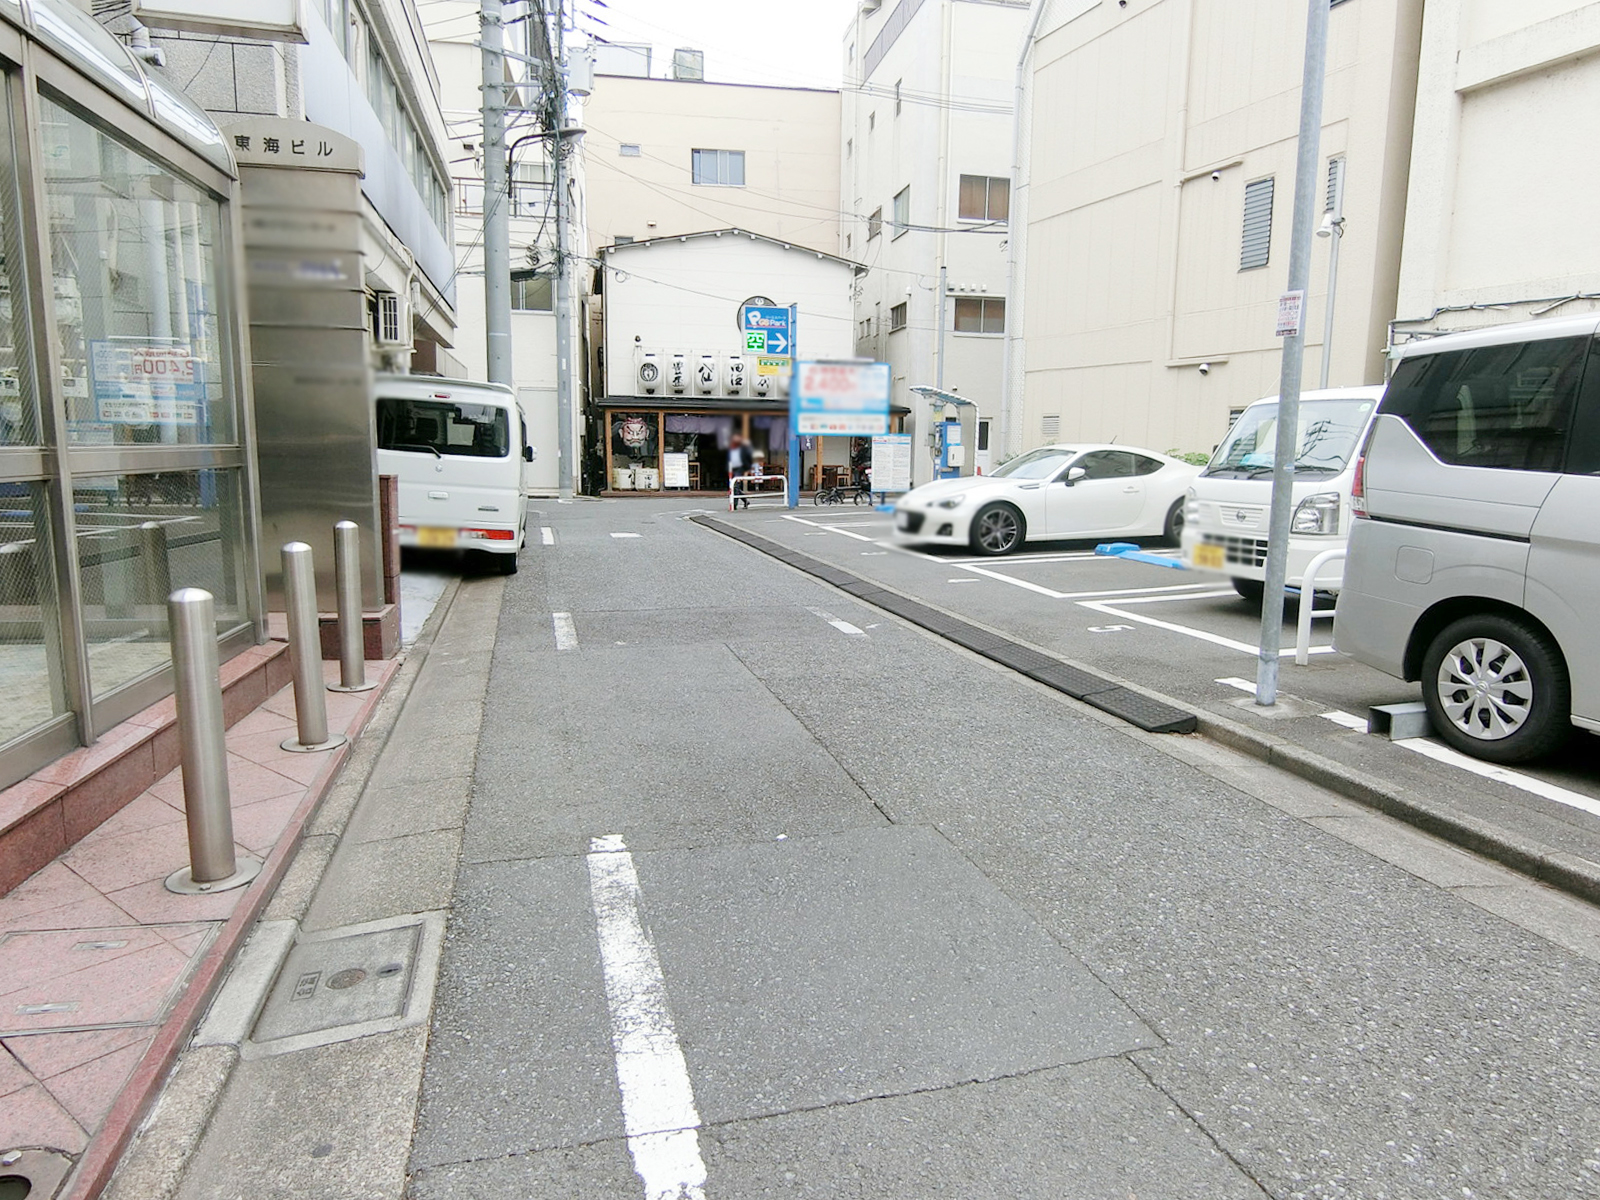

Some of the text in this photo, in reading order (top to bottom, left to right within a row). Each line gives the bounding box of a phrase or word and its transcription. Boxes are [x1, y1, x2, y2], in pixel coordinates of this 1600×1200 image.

[234, 135, 333, 156] 東海ビル
[770, 319, 787, 327] Park
[747, 332, 765, 352] 空
